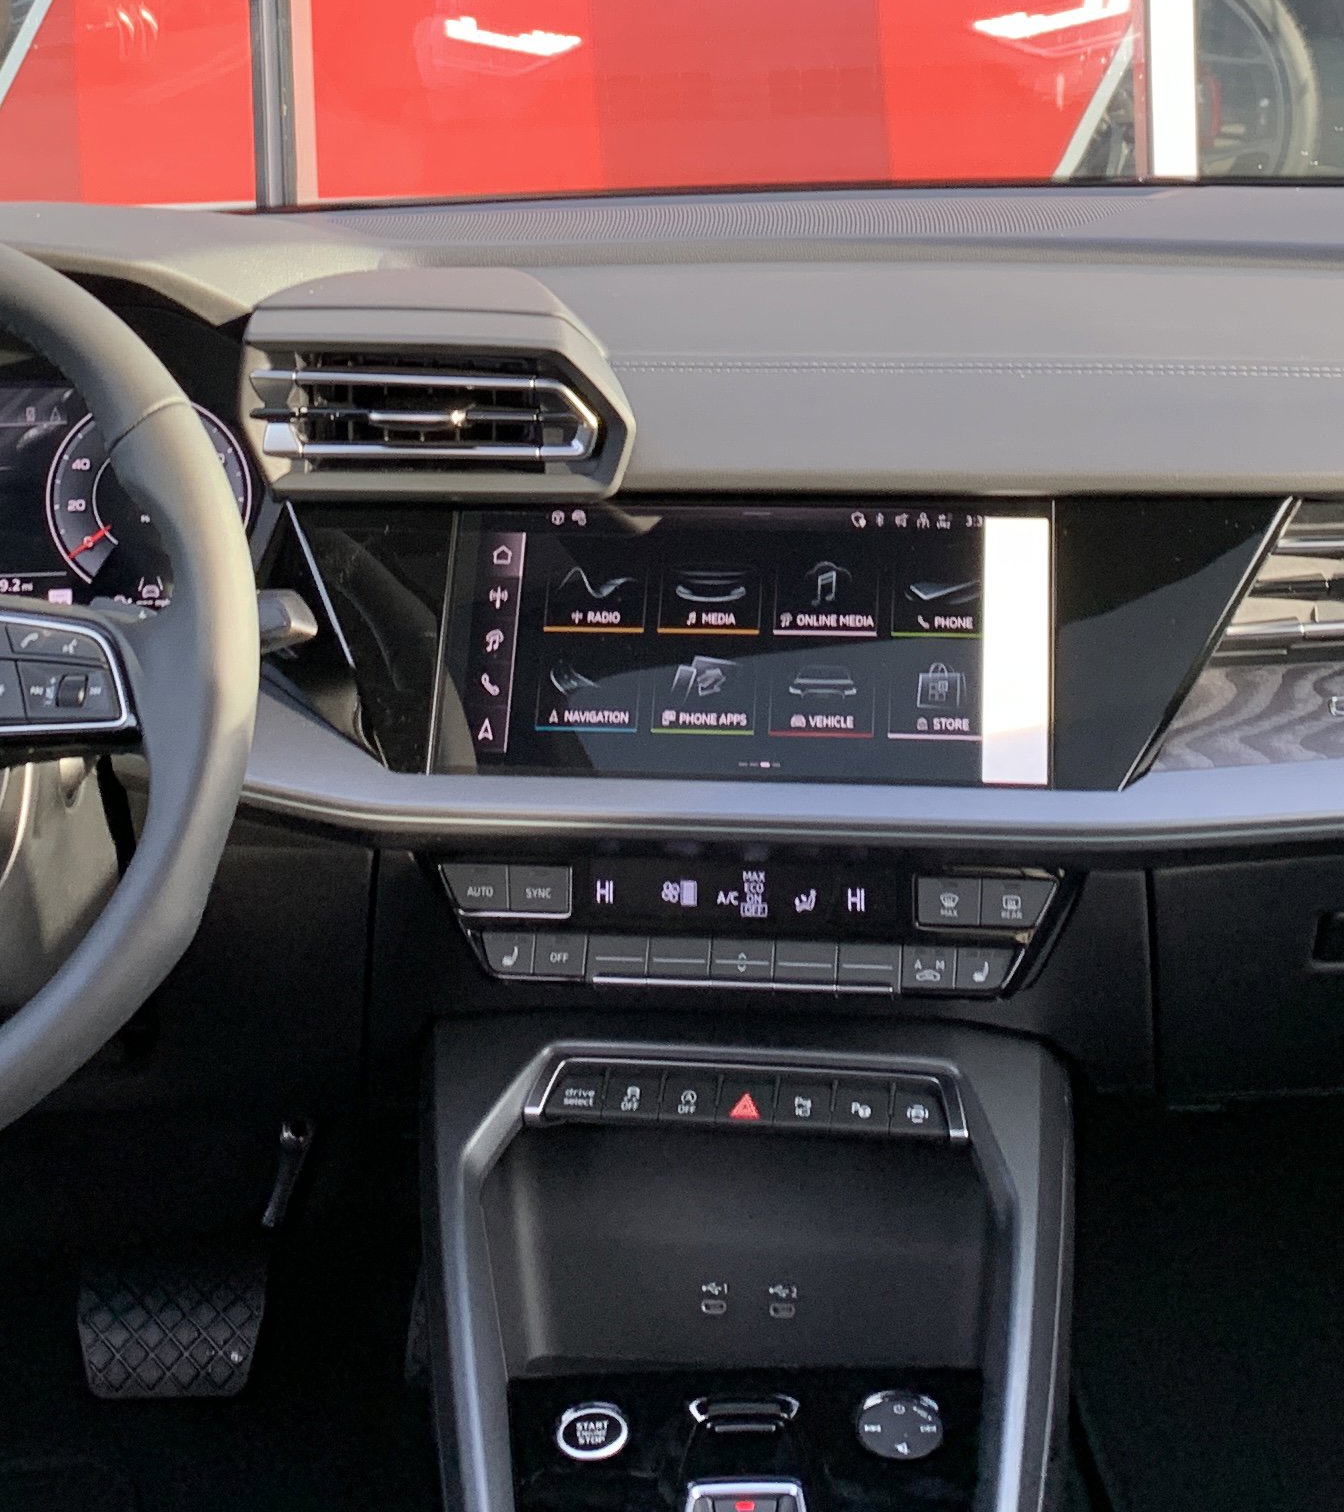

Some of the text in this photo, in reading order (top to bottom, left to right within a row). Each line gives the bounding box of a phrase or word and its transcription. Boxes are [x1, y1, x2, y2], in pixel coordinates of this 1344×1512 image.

[72, 457, 91, 471] 40
[67, 499, 86, 512] 20
[587, 610, 621, 624] RADIO
[701, 612, 736, 626] MEDIA
[796, 614, 874, 628] ONLINE MEDIA
[934, 615, 974, 629] PHONE
[564, 709, 629, 724] NAVIGATION
[679, 711, 747, 726] PHONE APPS
[808, 714, 854, 729] VEHICLE
[932, 717, 970, 731] STORE
[742, 871, 766, 883] MAX
[467, 886, 494, 897] AUTO
[525, 887, 552, 899] SYNC
[596, 879, 614, 904] HI
[744, 883, 765, 893] ECO
[716, 890, 739, 906] A/C
[746, 893, 762, 904] ON
[847, 887, 866, 912] HI
[940, 909, 959, 917] MAX
[1000, 910, 1023, 920] REAR
[549, 951, 569, 964] OFF
[914, 959, 923, 970] A
[564, 1088, 596, 1098] drive
[563, 1097, 594, 1107] select
[620, 1101, 640, 1112] OFF
[677, 1104, 697, 1115] OFF
[576, 1420, 608, 1431] START
[578, 1435, 606, 1445] STOP
